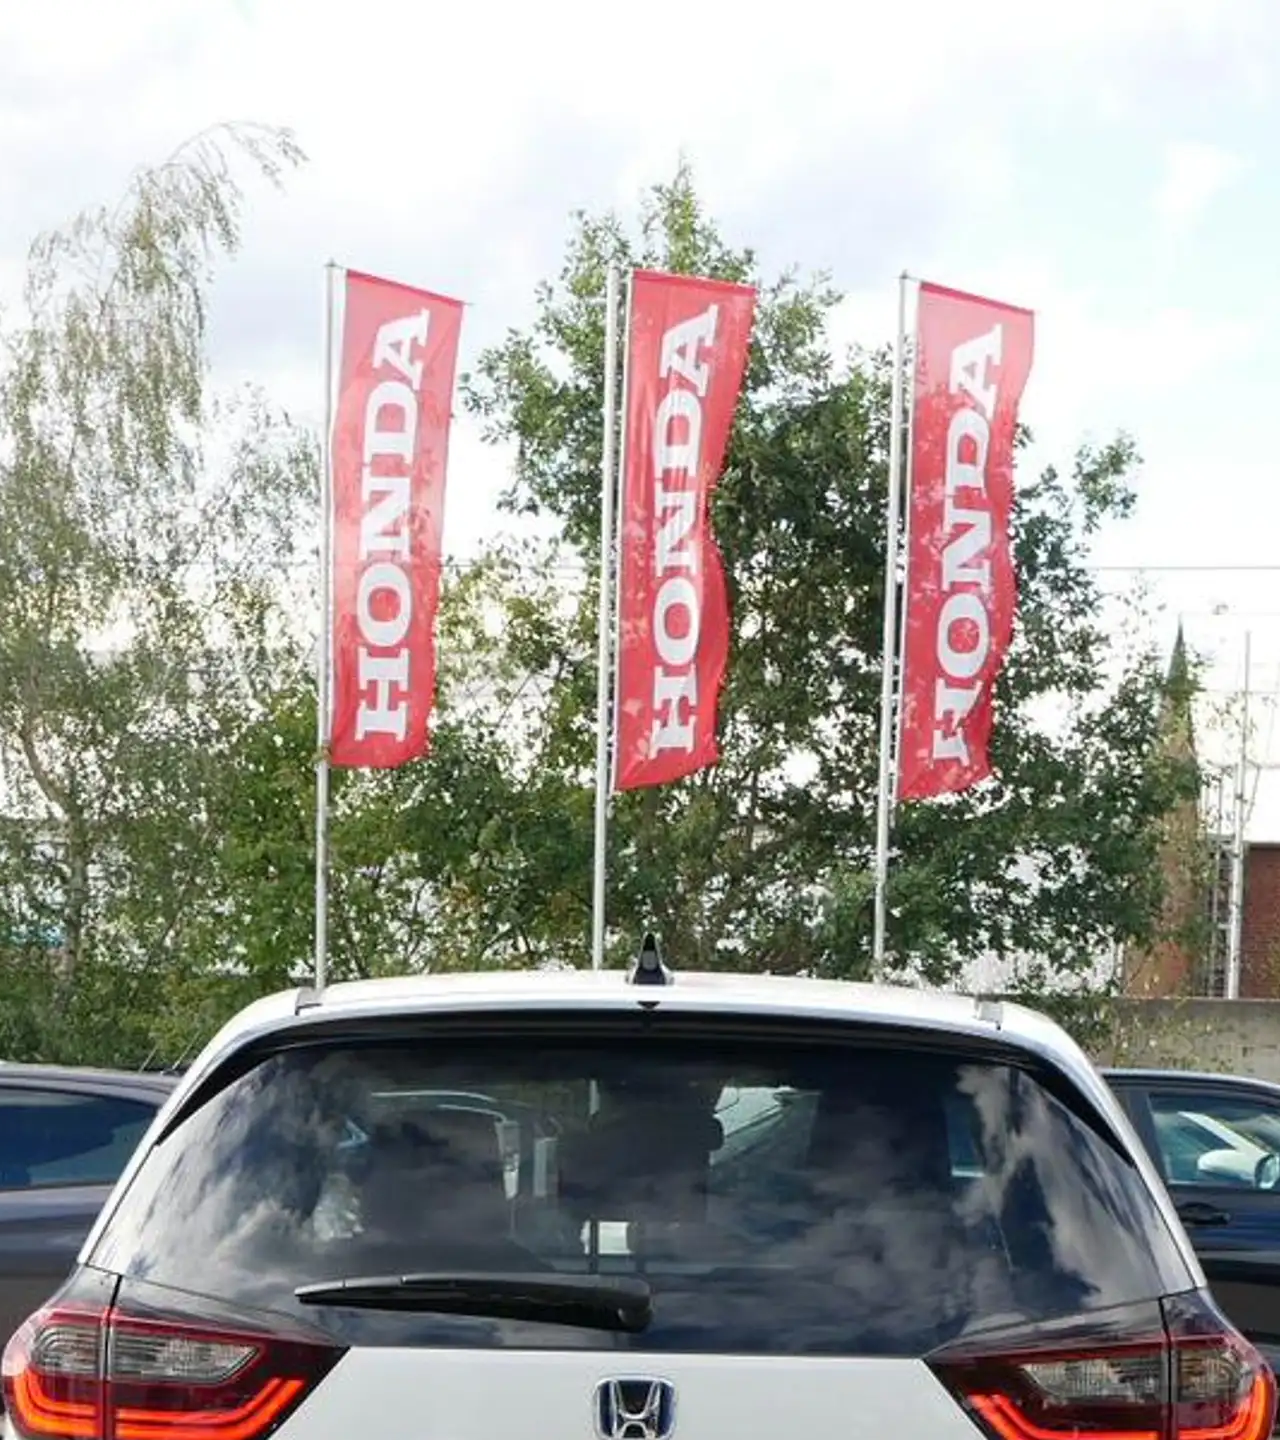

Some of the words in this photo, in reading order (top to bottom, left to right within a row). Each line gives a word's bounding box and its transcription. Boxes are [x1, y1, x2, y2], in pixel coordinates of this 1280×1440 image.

[355, 309, 430, 742] HONDA
[648, 304, 718, 761] HONDA
[930, 324, 1004, 767] HONDA
